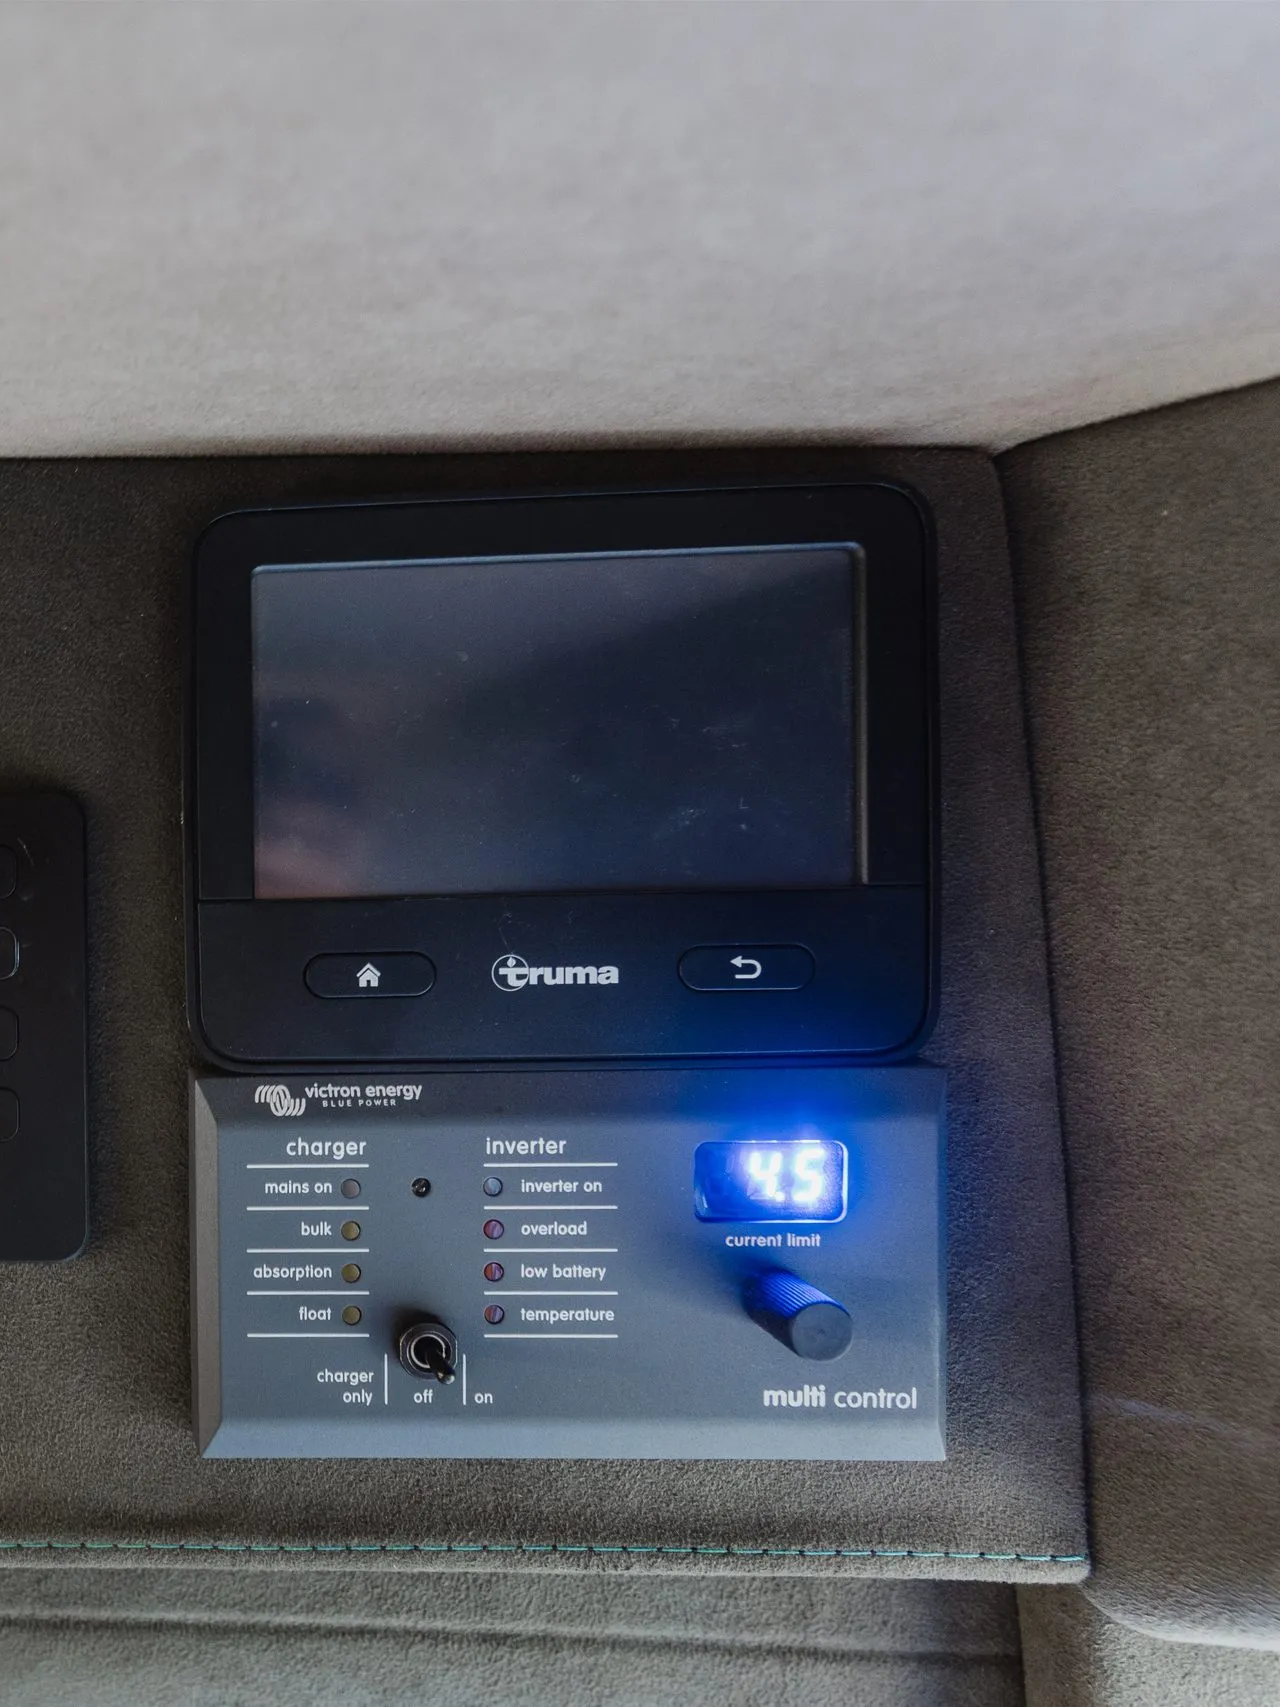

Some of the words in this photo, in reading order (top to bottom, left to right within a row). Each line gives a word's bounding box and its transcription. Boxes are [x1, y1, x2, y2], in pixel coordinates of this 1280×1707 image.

[497, 955, 620, 988] truma
[304, 1083, 361, 1099] victron
[365, 1084, 423, 1100] energy
[322, 1099, 353, 1108] BLUE
[358, 1098, 397, 1107] POWER
[286, 1136, 367, 1160] charger
[485, 1137, 567, 1155] inverter
[264, 1180, 310, 1194] mains
[314, 1182, 333, 1194] on
[521, 1179, 579, 1193] inverter
[583, 1181, 603, 1193] on
[301, 1221, 332, 1236] bulk
[521, 1220, 588, 1236] overload
[725, 1233, 782, 1248] current
[786, 1232, 821, 1248] limit
[253, 1264, 333, 1281] absorption
[520, 1264, 548, 1278] low
[552, 1264, 607, 1281] battery
[298, 1306, 332, 1321] float
[520, 1308, 615, 1324] temperature
[316, 1368, 375, 1386] charger
[342, 1388, 373, 1406] only
[413, 1389, 434, 1404] off
[474, 1392, 494, 1404] on
[762, 1384, 826, 1408] multi
[833, 1386, 919, 1410] control
